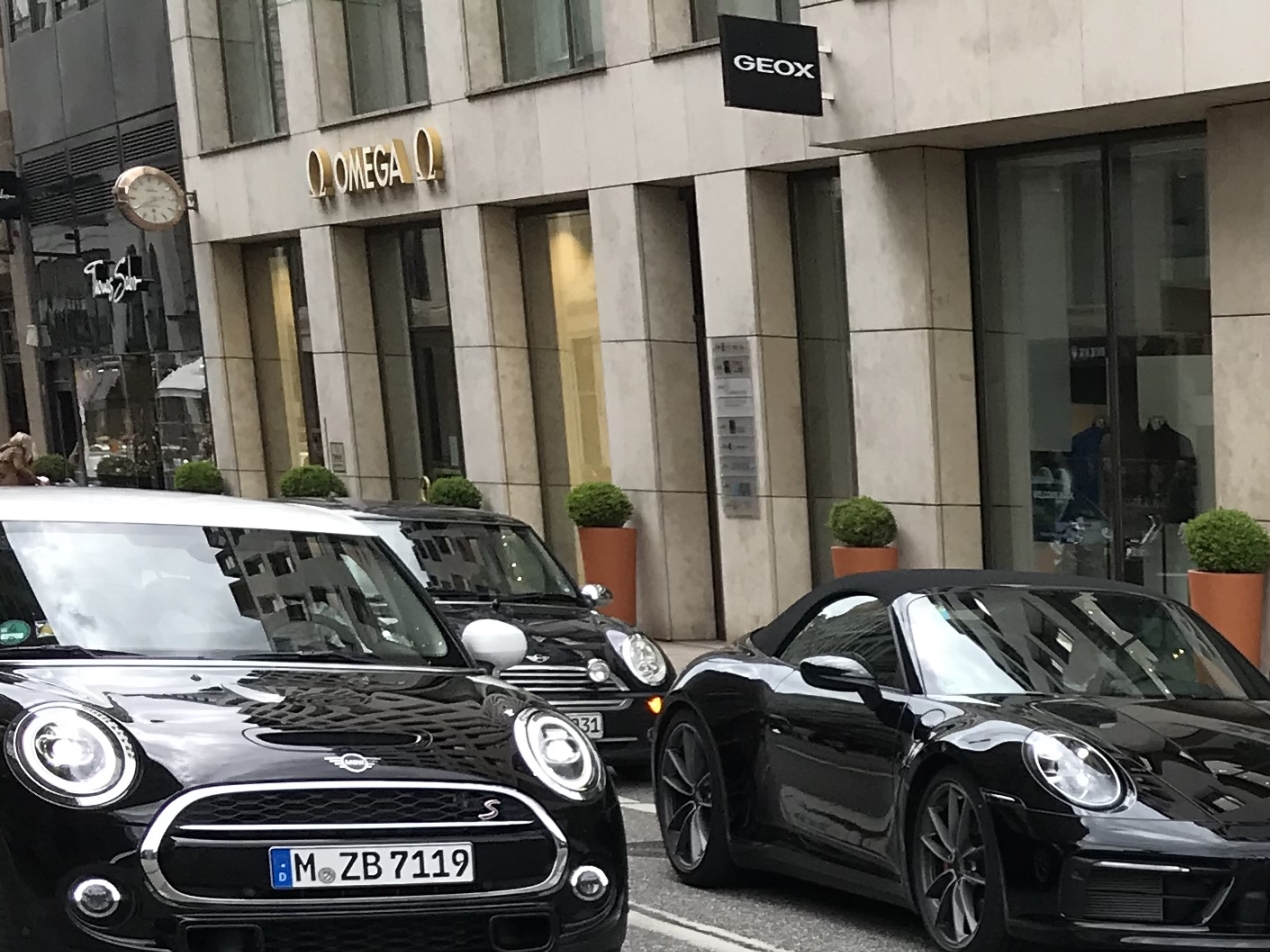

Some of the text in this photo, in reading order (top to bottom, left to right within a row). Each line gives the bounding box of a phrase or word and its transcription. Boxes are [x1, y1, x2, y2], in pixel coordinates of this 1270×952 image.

[733, 54, 815, 79] GEOX
[334, 141, 409, 194] OMEGA
[478, 799, 501, 821] S
[294, 849, 470, 882] M ZB 7119
